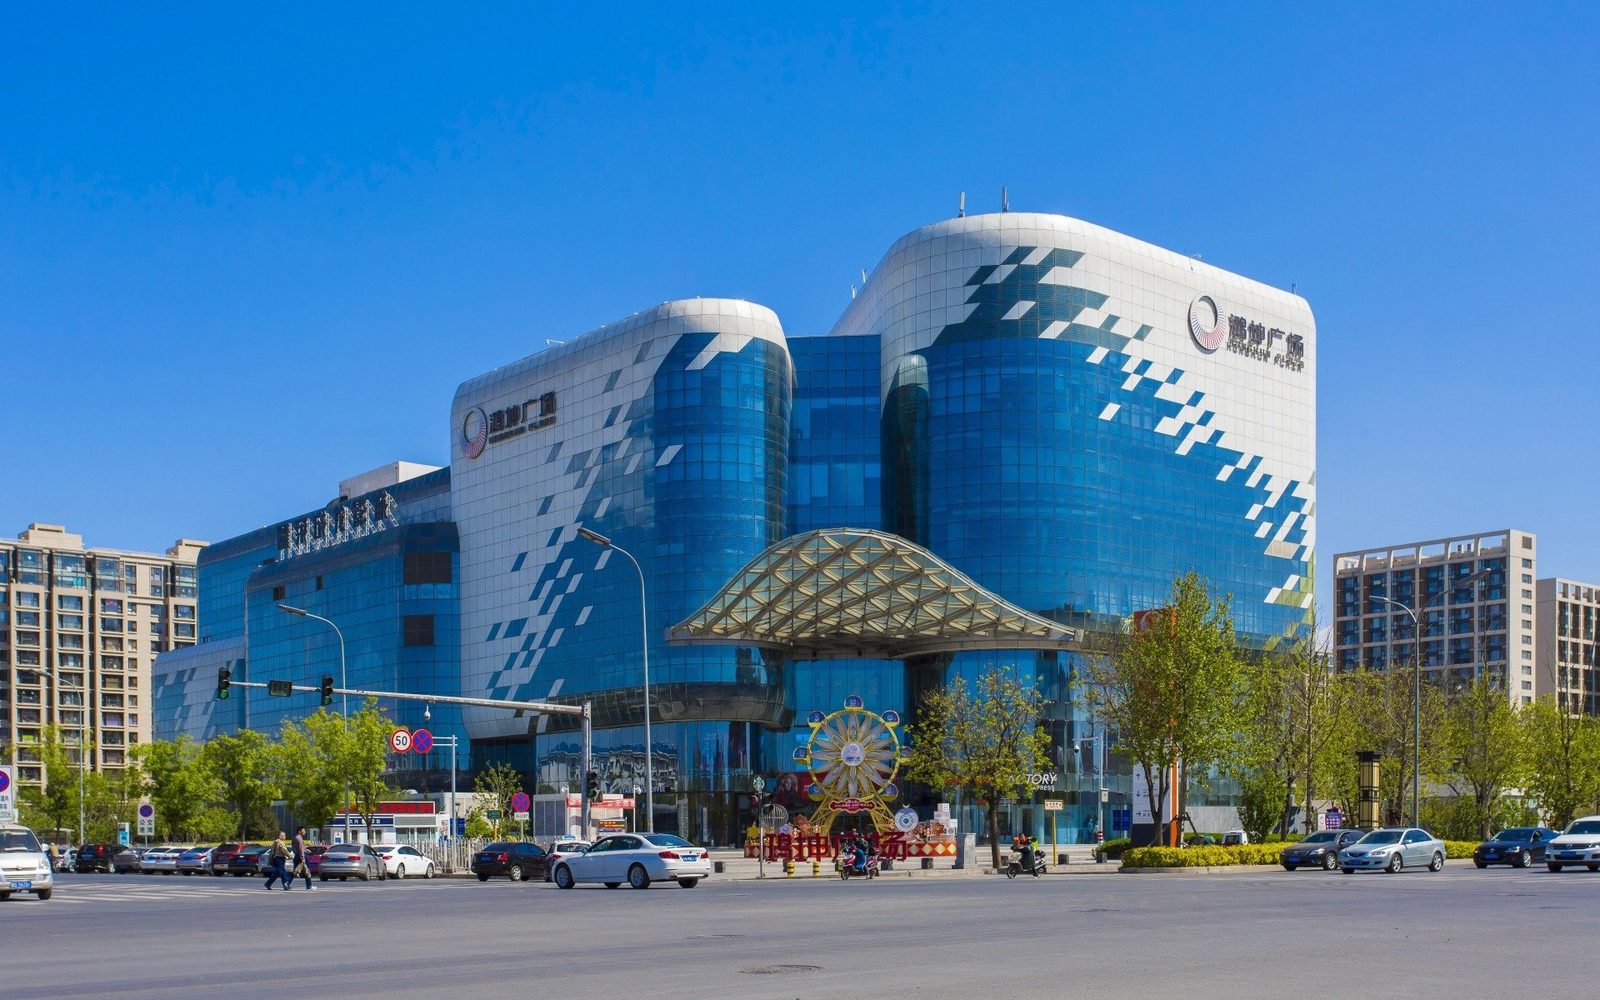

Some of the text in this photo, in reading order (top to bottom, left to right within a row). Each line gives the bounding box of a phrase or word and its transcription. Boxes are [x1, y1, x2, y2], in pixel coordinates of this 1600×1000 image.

[1228, 314, 1304, 357] 鸿坤广场
[395, 735, 408, 746] 50
